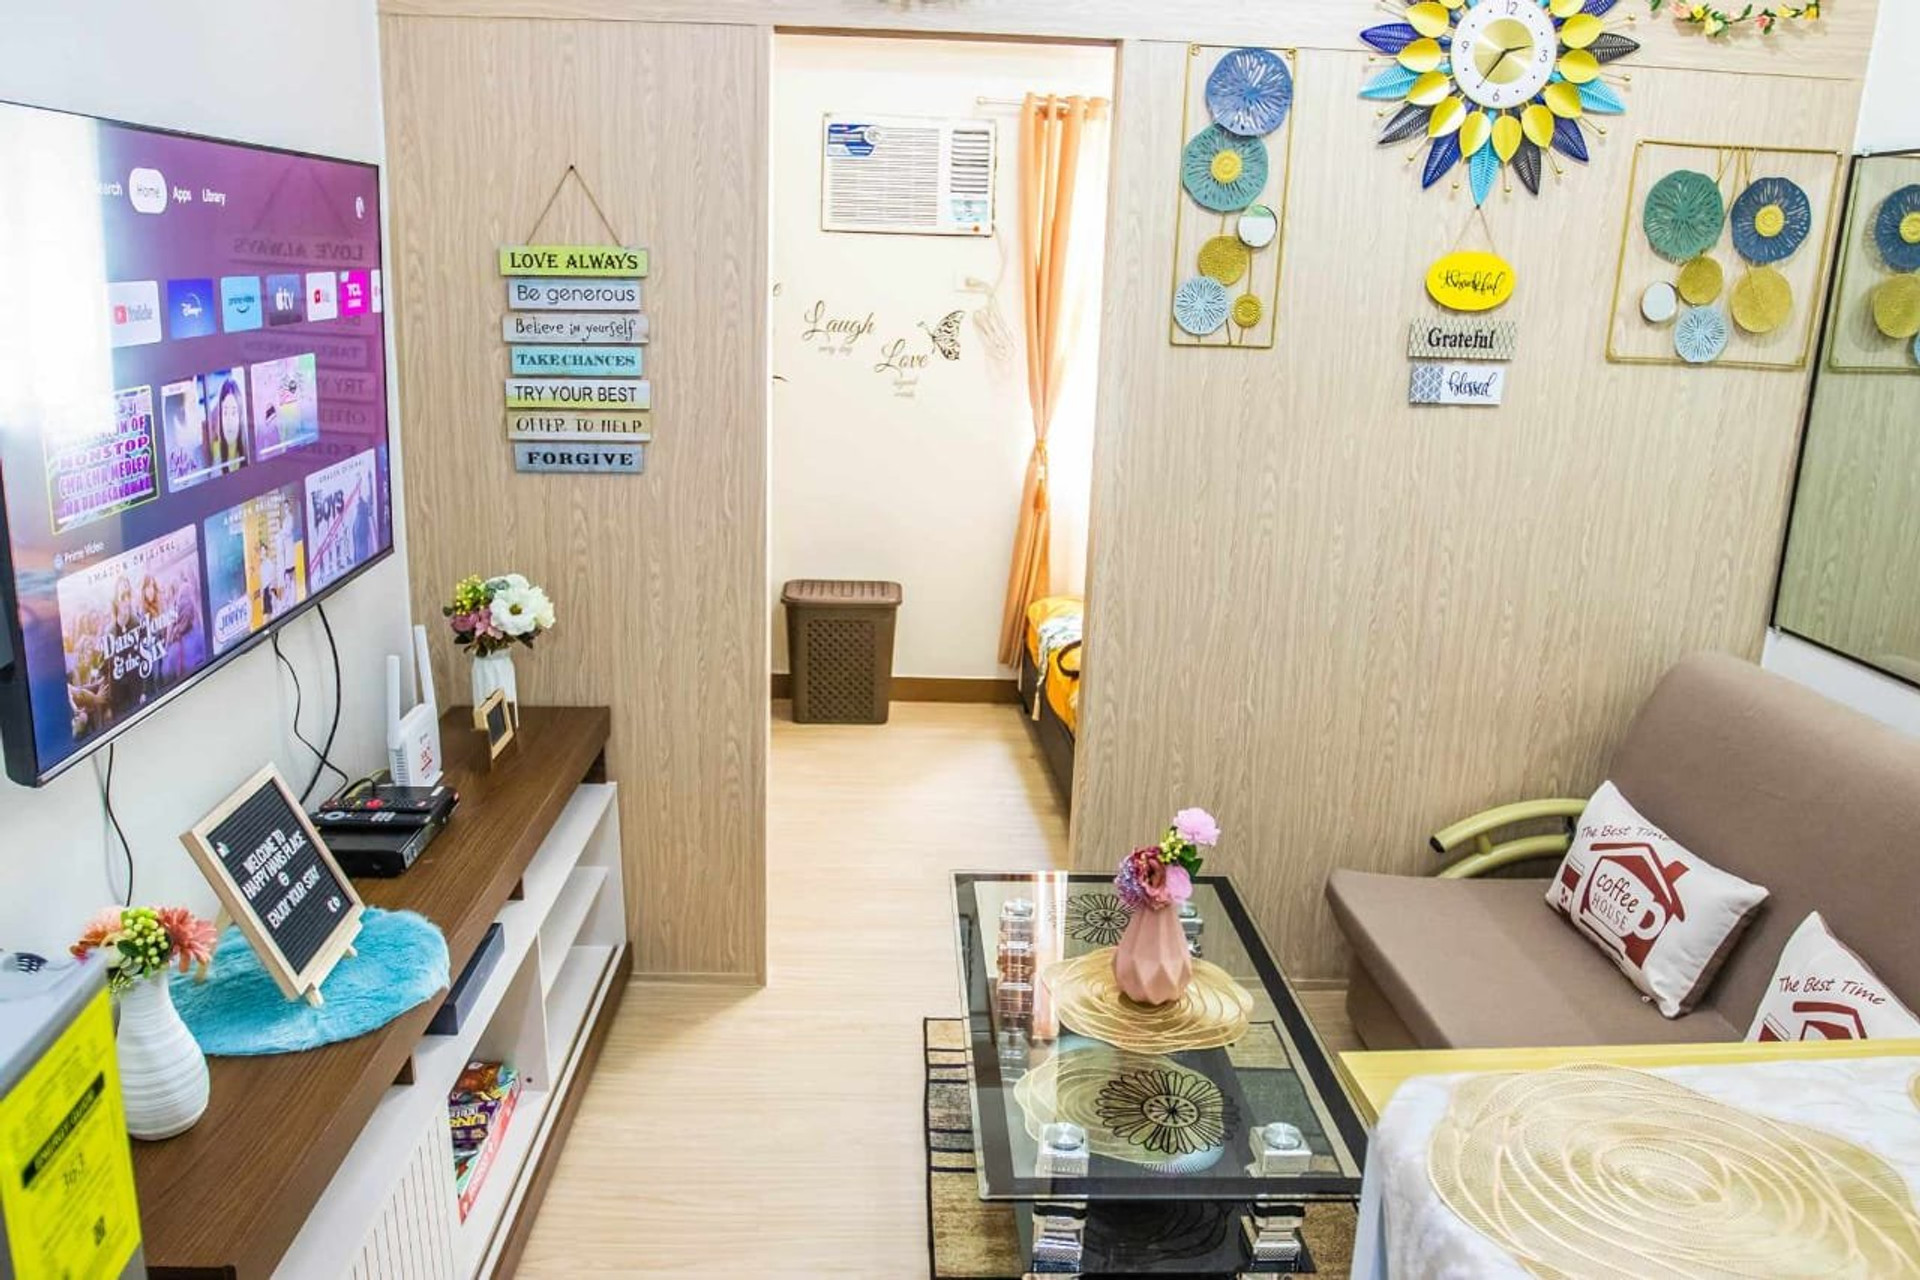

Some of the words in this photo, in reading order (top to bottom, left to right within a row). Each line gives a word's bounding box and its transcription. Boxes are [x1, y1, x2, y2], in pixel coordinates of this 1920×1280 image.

[1505, 0, 1518, 15] 12
[1539, 49, 1548, 63] 3
[1492, 87, 1500, 102] 6
[173, 185, 192, 204] Apps
[202, 187, 226, 207] Library
[510, 252, 559, 269] LOVE
[566, 252, 638, 270] ALWAYS
[517, 285, 541, 301] Be
[547, 287, 636, 305] generous
[515, 317, 564, 335] Believe
[581, 318, 637, 342] yourself
[802, 300, 876, 345] Laugh
[1427, 326, 1496, 349] Grateful
[516, 353, 561, 367] TAKE
[562, 354, 636, 367] CHANCES
[874, 338, 929, 379] Love
[514, 385, 544, 402] TRY
[549, 386, 597, 402] YOUR
[599, 387, 637, 402] BEST
[576, 418, 594, 433] TO
[601, 419, 643, 434] HELP
[527, 451, 634, 467] FORGIVE
[1581, 826, 1598, 839] The
[1600, 824, 1630, 838] Best
[1596, 873, 1640, 914] coffee
[1591, 894, 1630, 931] HOUSE
[1778, 975, 1799, 994] The
[1803, 976, 1837, 993] Best
[1841, 980, 1886, 1006] Time
